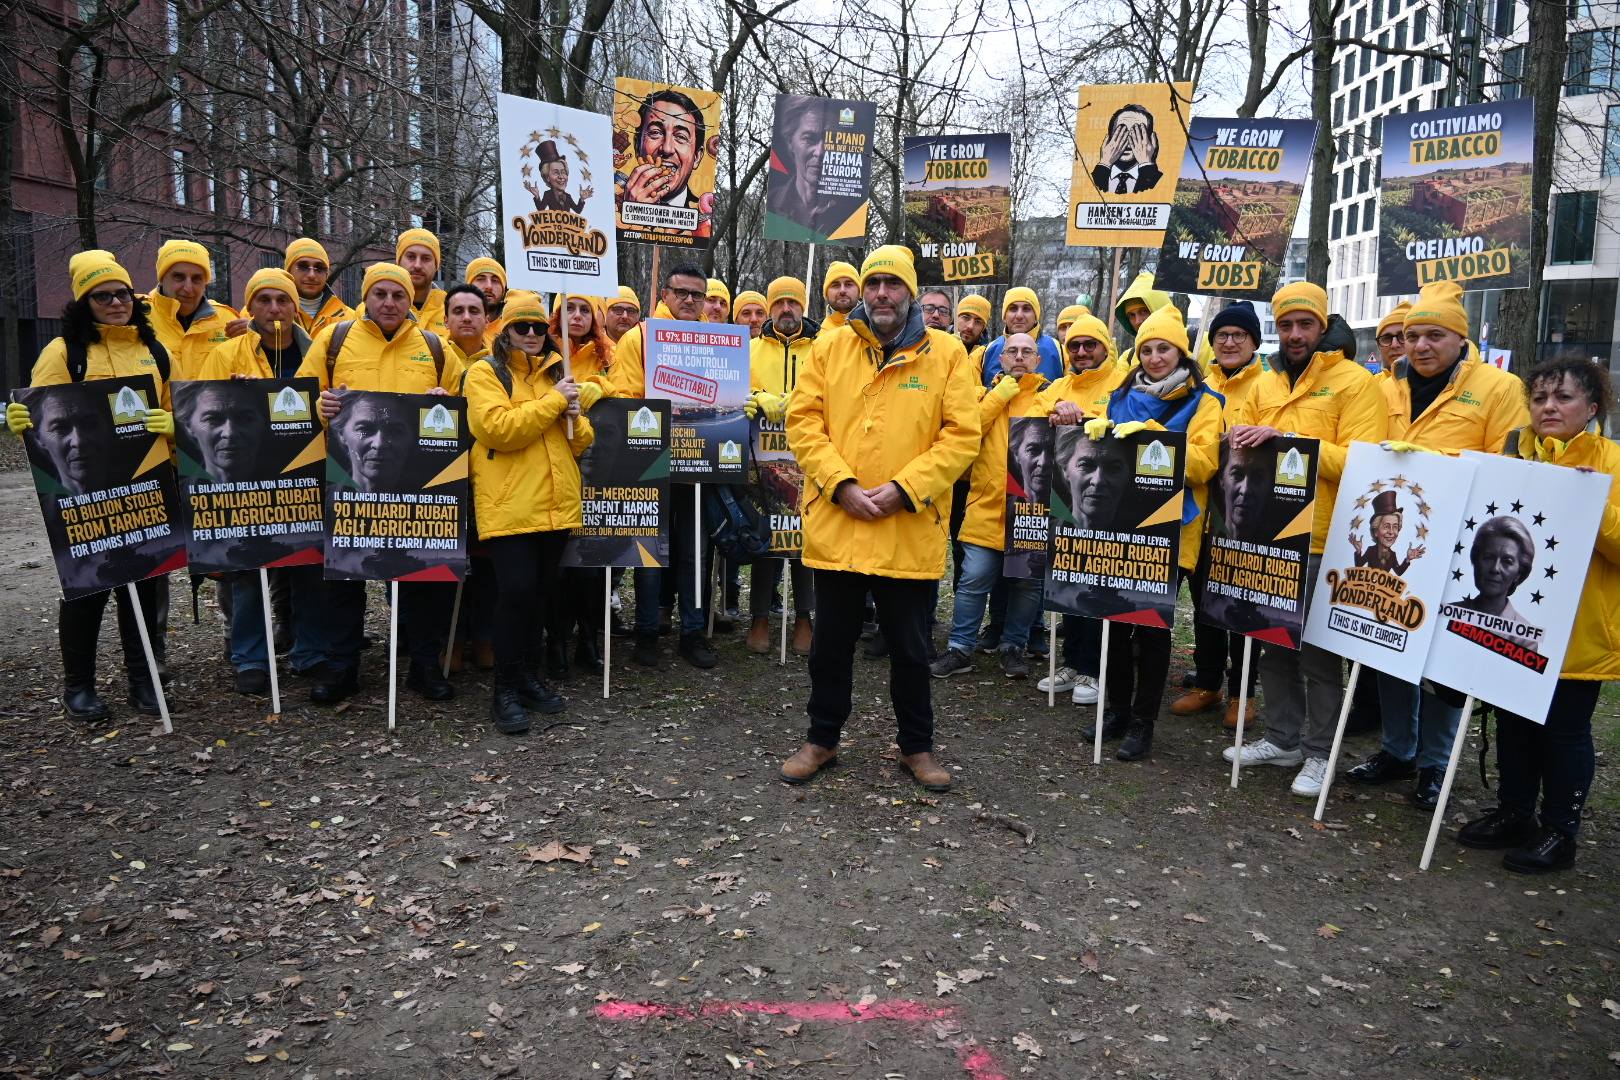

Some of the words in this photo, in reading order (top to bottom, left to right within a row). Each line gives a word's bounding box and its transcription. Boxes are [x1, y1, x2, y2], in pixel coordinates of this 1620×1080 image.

[1410, 113, 1502, 139] COLTIVIAMO
[825, 131, 833, 143] IL
[836, 132, 865, 146] PIANO
[1216, 128, 1238, 146] WE
[1240, 129, 1283, 148] GROW
[836, 144, 846, 152] DER
[930, 144, 946, 160] WE
[950, 144, 985, 159] GROW
[1412, 134, 1498, 163] TABACCO
[823, 151, 862, 167] AFFAMA
[1208, 149, 1280, 170] TOBACCO
[822, 165, 861, 178] L'EUROPA
[927, 161, 987, 180] TOBACCO
[626, 205, 669, 217] COMMISSIONER
[672, 211, 695, 220] HANSEN
[1088, 206, 1131, 218] HANSEN'S
[1135, 207, 1158, 218] GAZE
[531, 213, 585, 229] WELCOME
[514, 218, 606, 255] VONDERLAND
[921, 244, 938, 258] WE
[943, 243, 977, 257] GROW
[1179, 242, 1200, 259] WE
[1204, 243, 1246, 262] GROW
[1405, 236, 1484, 260] CREIAMO
[532, 256, 548, 268] THIS
[550, 258, 556, 269] IS
[559, 259, 572, 269] NOT
[573, 260, 597, 271] EUROPE
[948, 256, 990, 278] JOBS
[1422, 251, 1506, 283] LAVORO
[1202, 264, 1256, 286] JOBS
[658, 332, 664, 341] IL
[666, 332, 680, 342] 97%
[682, 333, 692, 343] DEI
[695, 334, 708, 344] CIBI
[710, 335, 730, 345] EXTRA
[732, 336, 740, 346] UE
[663, 344, 682, 353] ENTRA
[684, 345, 690, 354] IN
[692, 346, 714, 355] EUROPA
[658, 354, 683, 367] SENZA
[685, 356, 728, 369] CONTROLLI
[704, 368, 740, 381] ADEGUATI
[658, 371, 713, 398] INACCETTABILE
[116, 424, 147, 434] COLDIRE
[271, 422, 312, 430] COLDIRETTI
[419, 439, 458, 447] COLDIRETTI
[681, 438, 706, 449] SALUTE
[670, 448, 702, 459] CITTADINI
[189, 485, 197, 494] IL
[198, 482, 234, 494] BILANCIO
[236, 481, 259, 491] DELLA
[260, 480, 277, 489] VON
[279, 479, 294, 488] DER
[295, 478, 319, 487] LEYEN:
[1135, 477, 1173, 486] COLDIRETTI
[58, 498, 74, 509] THE
[75, 495, 91, 506] VON
[92, 491, 107, 501] DER
[108, 485, 131, 499] LEYEN
[132, 480, 160, 495] BUDGET:
[190, 495, 208, 511] 90
[213, 490, 271, 509] MILIARDI
[276, 488, 320, 505] RUBATI
[334, 492, 341, 501] IL
[343, 492, 377, 501] BILANCIO
[379, 493, 400, 502] DELLA
[402, 494, 417, 503] VON
[419, 494, 433, 504] DER
[435, 495, 458, 504] LEYEN:
[1274, 486, 1305, 497] COLDIRETTI
[62, 508, 78, 524] 90
[80, 498, 122, 520] BILLION
[126, 490, 164, 511] STOLEN
[334, 502, 350, 518] 90
[355, 503, 411, 520] MILIARDI
[415, 505, 458, 520] RUBATI
[582, 501, 621, 514] EEMENT
[623, 501, 658, 514] HARMS
[1014, 502, 1030, 516] THE
[66, 521, 106, 544] FROM
[109, 506, 168, 532] FARMERS
[193, 510, 226, 529] AGLI
[230, 504, 322, 527] AGRICOLTORI
[606, 515, 638, 527] HEALTH
[640, 515, 658, 527] AND
[1014, 515, 1049, 529] AGREEM
[193, 529, 212, 541] PER
[215, 526, 248, 539] BOMBE
[251, 526, 257, 536] E
[260, 523, 287, 536] CARRI
[290, 521, 323, 534] ARMATI
[333, 519, 366, 536] AGLI
[370, 520, 458, 538] AGRICOLTORI
[599, 528, 612, 536] OUR
[614, 528, 658, 536] AGRICULTURE
[1014, 529, 1048, 540] CITIZENS
[1056, 526, 1061, 535] IL
[1063, 527, 1094, 539] BILANCIO
[1095, 530, 1115, 541] DELLA
[1116, 532, 1131, 543] VON
[1132, 534, 1146, 545] DER
[1148, 536, 1170, 547] LEYEN:
[70, 546, 88, 559] FOR
[91, 537, 123, 554] BOMBS
[125, 530, 143, 545] AND
[144, 524, 171, 540] TANKS
[332, 537, 350, 548] PER
[353, 536, 385, 549] BOMBE
[388, 538, 393, 549] E
[395, 538, 422, 549] CARRI
[425, 538, 458, 550] ARMATI
[1014, 541, 1044, 550] SACRIFICES
[1055, 537, 1068, 552] 90
[1073, 539, 1124, 558] MILIARDI
[1128, 545, 1170, 564] RUBATI
[1053, 553, 1080, 571] AGLI
[1084, 557, 1168, 582] AGRICOLTORI
[1211, 548, 1222, 563] 90
[1224, 549, 1263, 572] MILIARDI
[1266, 558, 1300, 580] RUBATI
[1052, 570, 1067, 582] PER
[1070, 572, 1098, 585] BOMBE
[1101, 576, 1106, 587] E
[1108, 577, 1133, 590] CARRI
[1136, 580, 1168, 594] ARMATI
[1208, 563, 1230, 584] AGLI
[1232, 568, 1298, 599] AGRICOLTORI
[1347, 569, 1405, 594] WELCOME
[1366, 583, 1375, 591] TO
[1327, 571, 1423, 629] VONDERLAND
[1334, 613, 1350, 629] THIS
[1351, 620, 1359, 631] IS
[1360, 623, 1375, 637] NOT
[1375, 628, 1403, 646] EUROPE
[1477, 613, 1513, 633] TURN
[1516, 624, 1543, 640] OFF
[1452, 621, 1546, 670] DEMOCRACY
